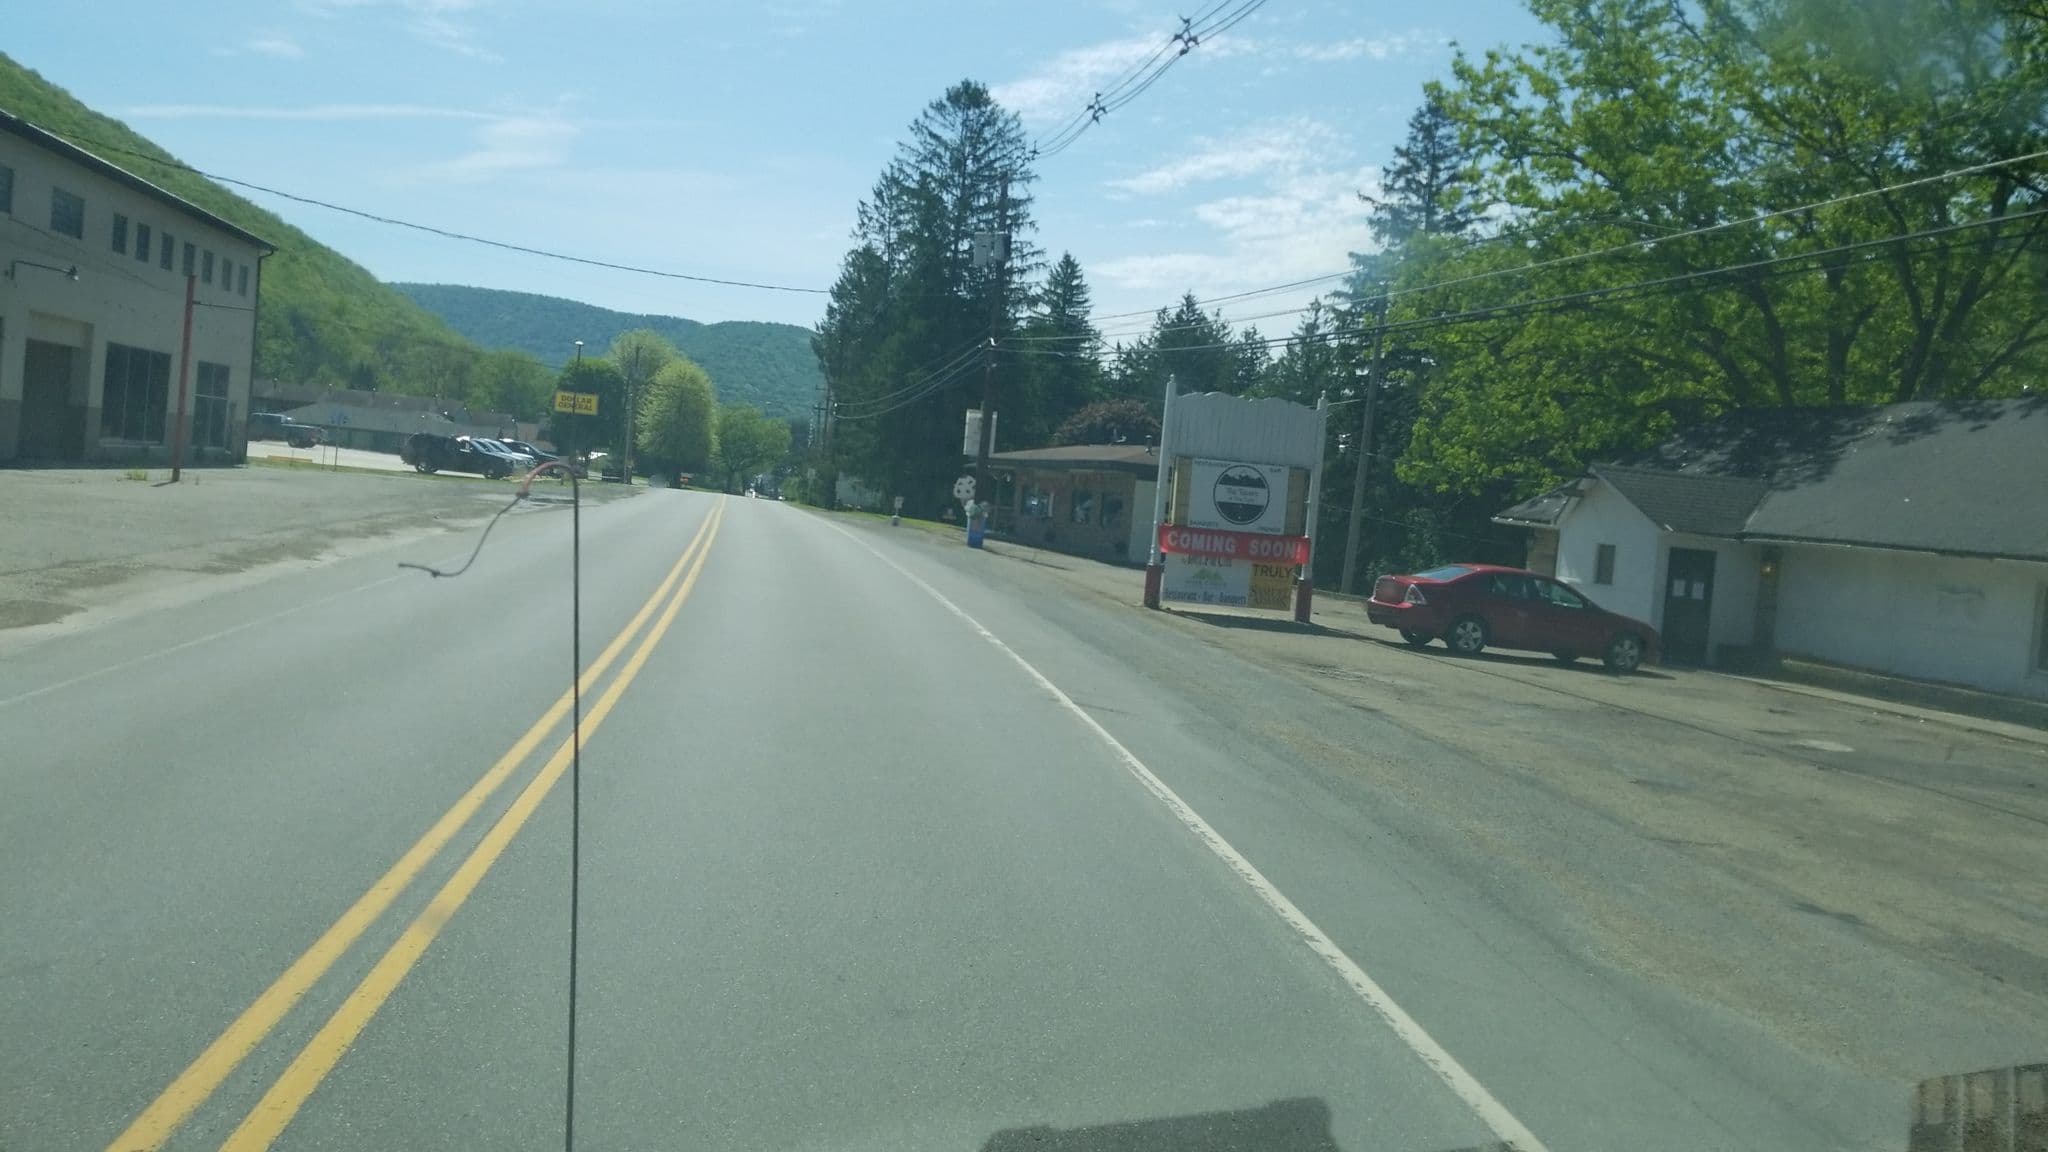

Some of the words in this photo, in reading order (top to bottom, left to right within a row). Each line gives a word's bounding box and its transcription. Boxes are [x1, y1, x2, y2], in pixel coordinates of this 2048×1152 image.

[558, 401, 592, 411] GENRAL
[1167, 531, 1236, 554] COMING
[1248, 539, 1302, 560] SOON!
[1253, 563, 1294, 578] TRULY
